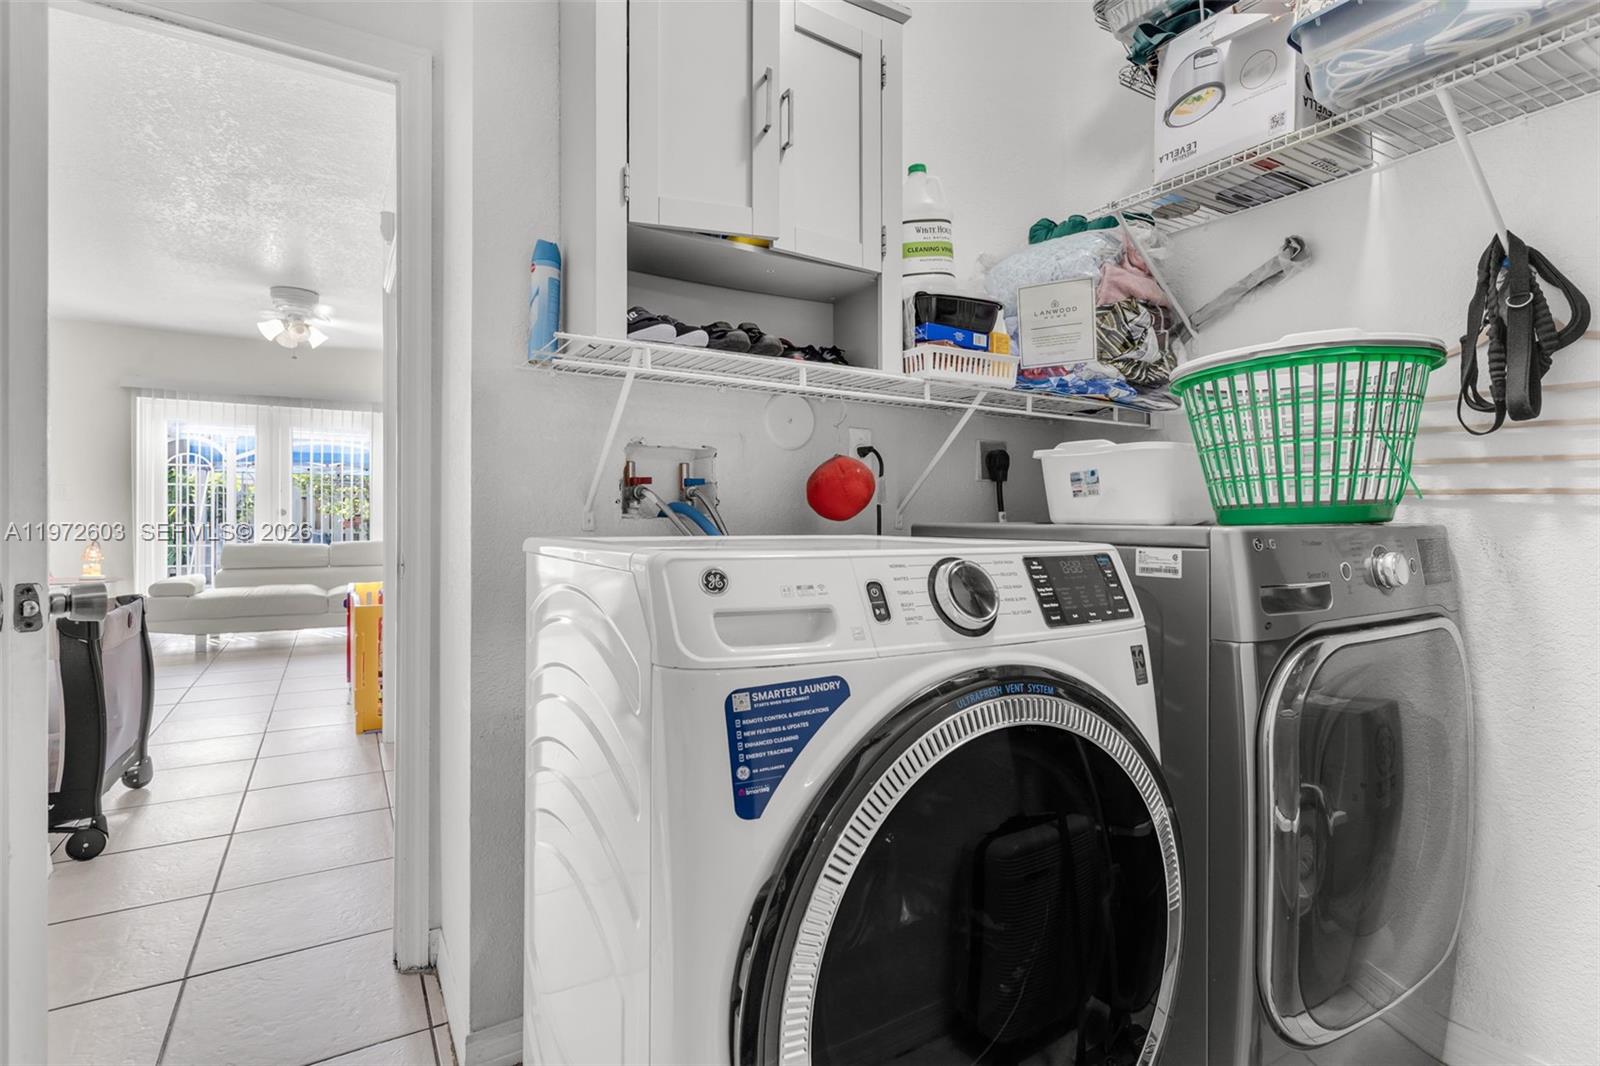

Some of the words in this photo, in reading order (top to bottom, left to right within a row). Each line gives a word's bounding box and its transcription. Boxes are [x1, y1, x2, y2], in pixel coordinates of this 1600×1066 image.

[1303, 95, 1336, 118] EVELLA
[1159, 141, 1197, 163] LEVELLA
[907, 246, 940, 254] CLEANING
[1034, 306, 1078, 317] LANWOOD
[752, 687, 797, 702] SMARTER
[799, 680, 841, 695] LAUNDRY
[956, 685, 1002, 709] ULTRAFRESH
[1005, 683, 1025, 693] VENT
[1027, 683, 1054, 695] SYSTEM
[742, 716, 763, 725] REMOTE
[764, 713, 787, 722] CONTROL
[793, 707, 829, 717] NOTIFICATIONS
[757, 726, 782, 735] FEATURES
[787, 722, 809, 730] UPDATES
[744, 739, 773, 748] ENHANCED
[774, 735, 799, 744] CLEANING
[746, 751, 766, 760] ENERGY
[767, 747, 794, 757] TRACKING
